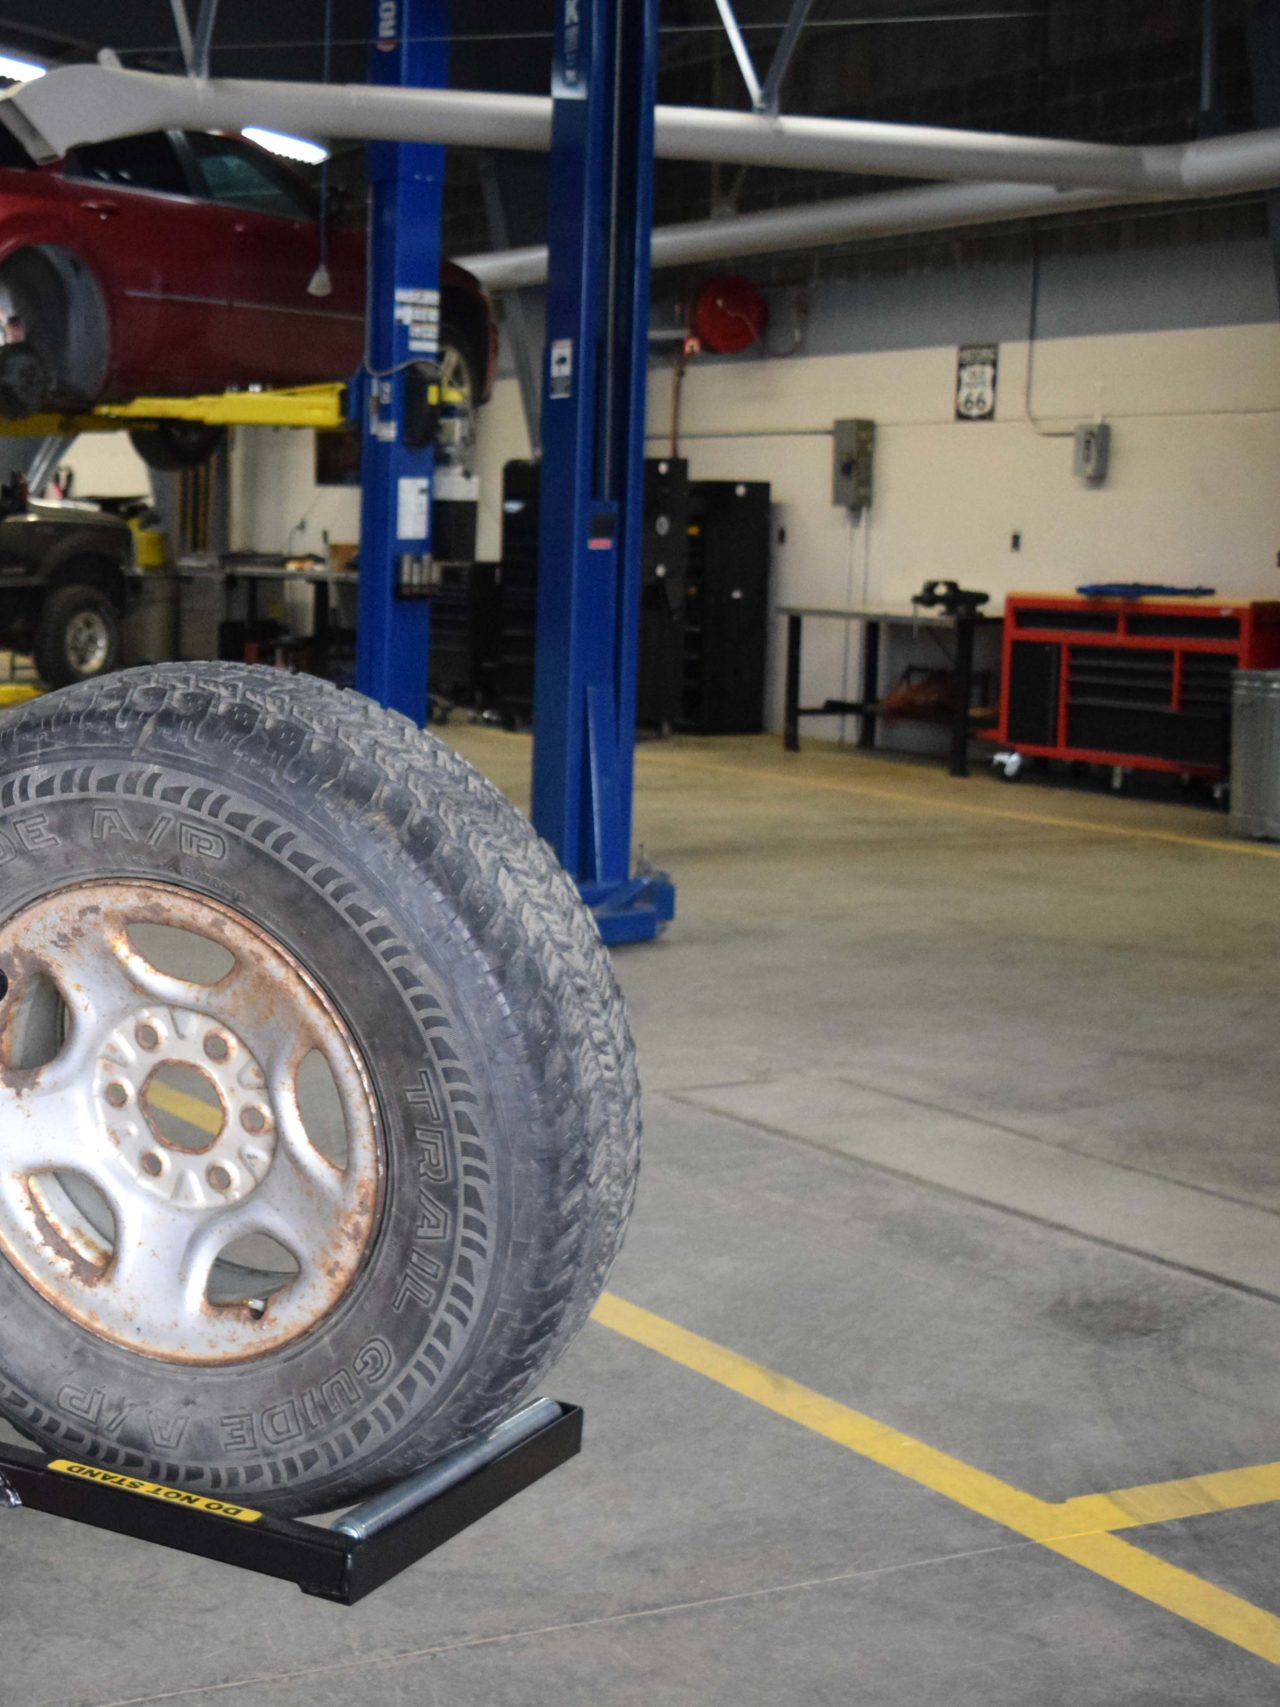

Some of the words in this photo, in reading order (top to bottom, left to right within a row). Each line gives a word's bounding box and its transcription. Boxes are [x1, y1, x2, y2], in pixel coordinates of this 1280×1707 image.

[963, 392, 987, 412] 66
[391, 1068, 450, 1314] TRAIL
[220, 1337, 393, 1451] GUIDE
[56, 1383, 191, 1449] A/P
[66, 1465, 145, 1489] STAND
[146, 1487, 200, 1504] NOT
[205, 1502, 242, 1516] DO
